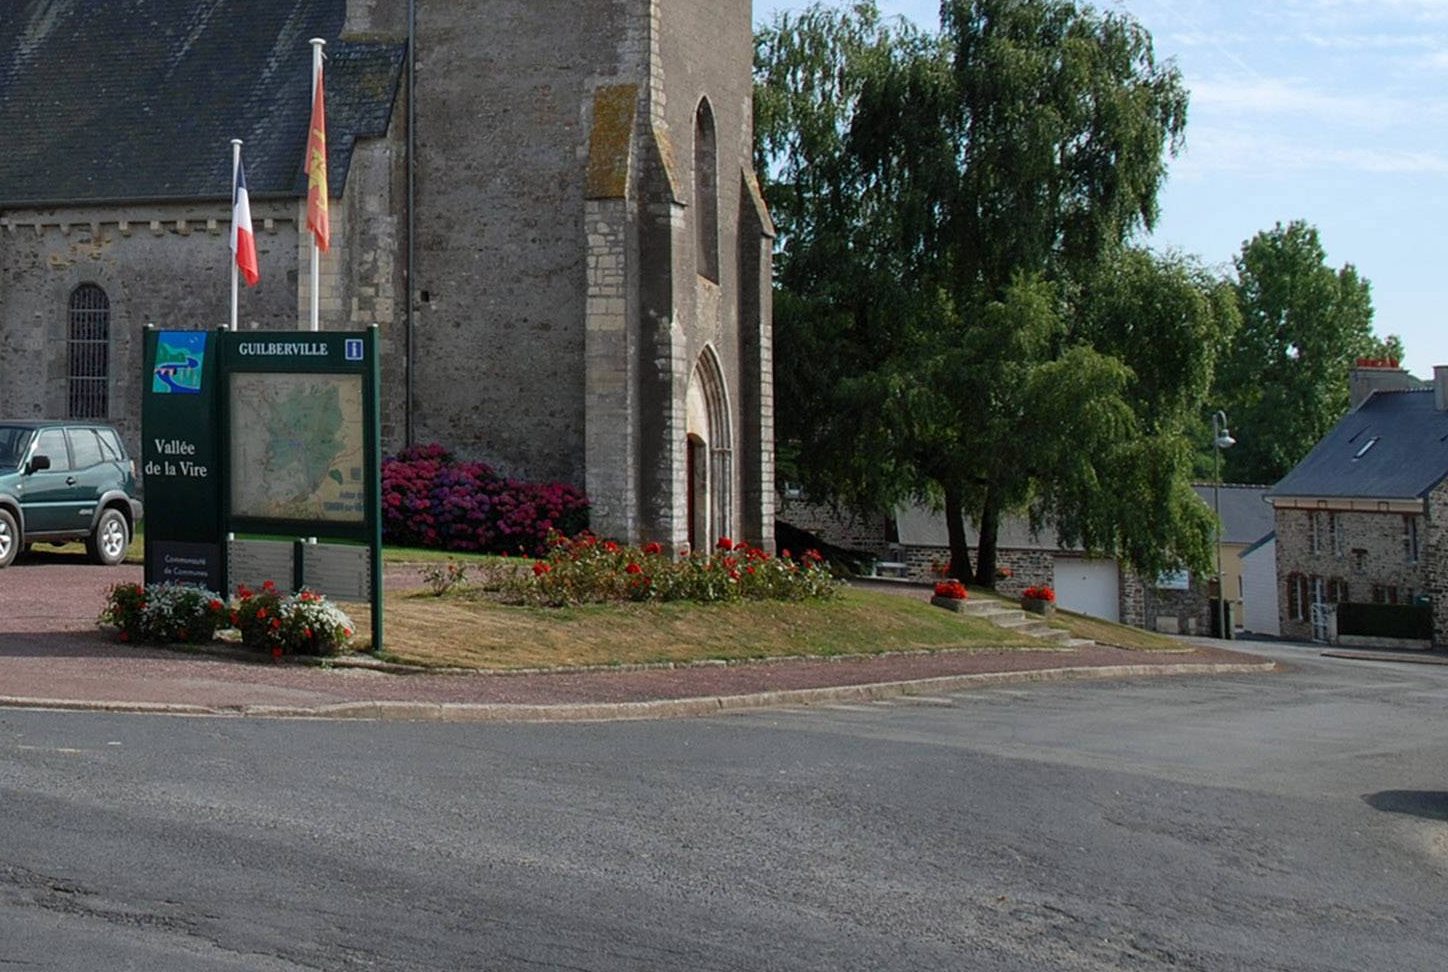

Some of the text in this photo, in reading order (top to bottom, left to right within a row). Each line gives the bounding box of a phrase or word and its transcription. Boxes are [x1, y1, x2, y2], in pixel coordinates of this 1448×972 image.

[239, 342, 329, 356] GUILBERVILLE
[154, 438, 195, 455] Vallée
[145, 460, 207, 477] de la Vire
